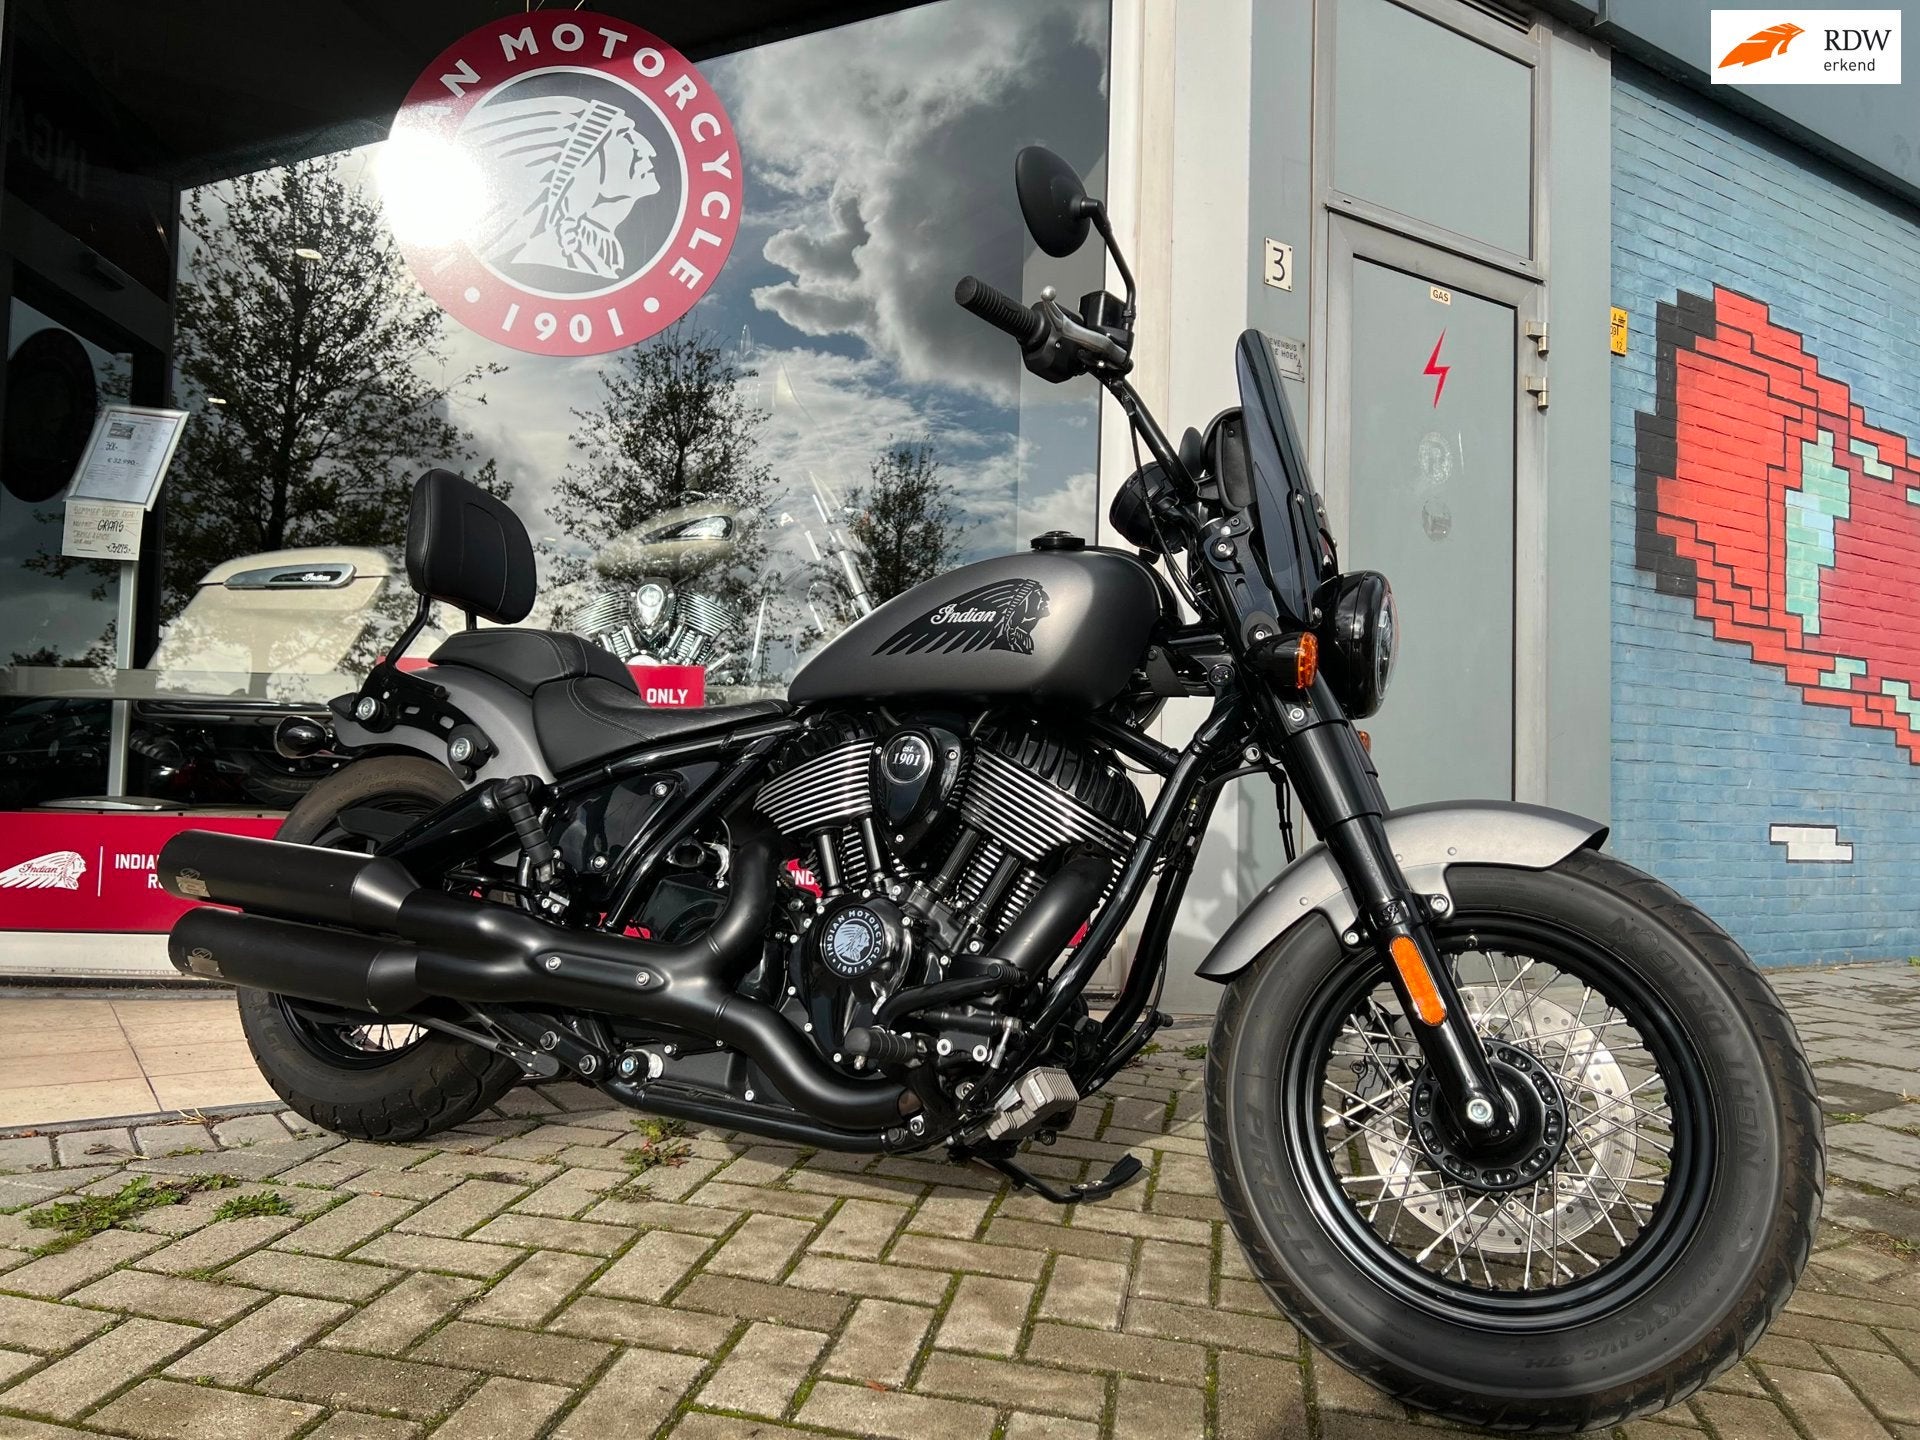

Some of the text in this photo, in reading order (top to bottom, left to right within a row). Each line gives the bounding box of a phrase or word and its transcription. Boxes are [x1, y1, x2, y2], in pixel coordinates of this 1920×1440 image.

[499, 23, 733, 289] MOTORCYCLE
[1272, 246, 1285, 281] 3
[1432, 289, 1449, 302] GAS
[501, 303, 624, 341] 1901
[1281, 350, 1298, 360] HOEK
[97, 519, 125, 533] GRATIS
[302, 572, 331, 582] Indian
[930, 603, 997, 625] Indian
[646, 688, 689, 704] ONLY
[892, 752, 921, 766] 1901
[18, 862, 58, 874] Indian
[115, 853, 160, 870] INDIA
[827, 910, 882, 967] INDIAN MOTORCYCLE
[837, 963, 857, 974] 1901
[1246, 1102, 1334, 1276] PIRELLI
